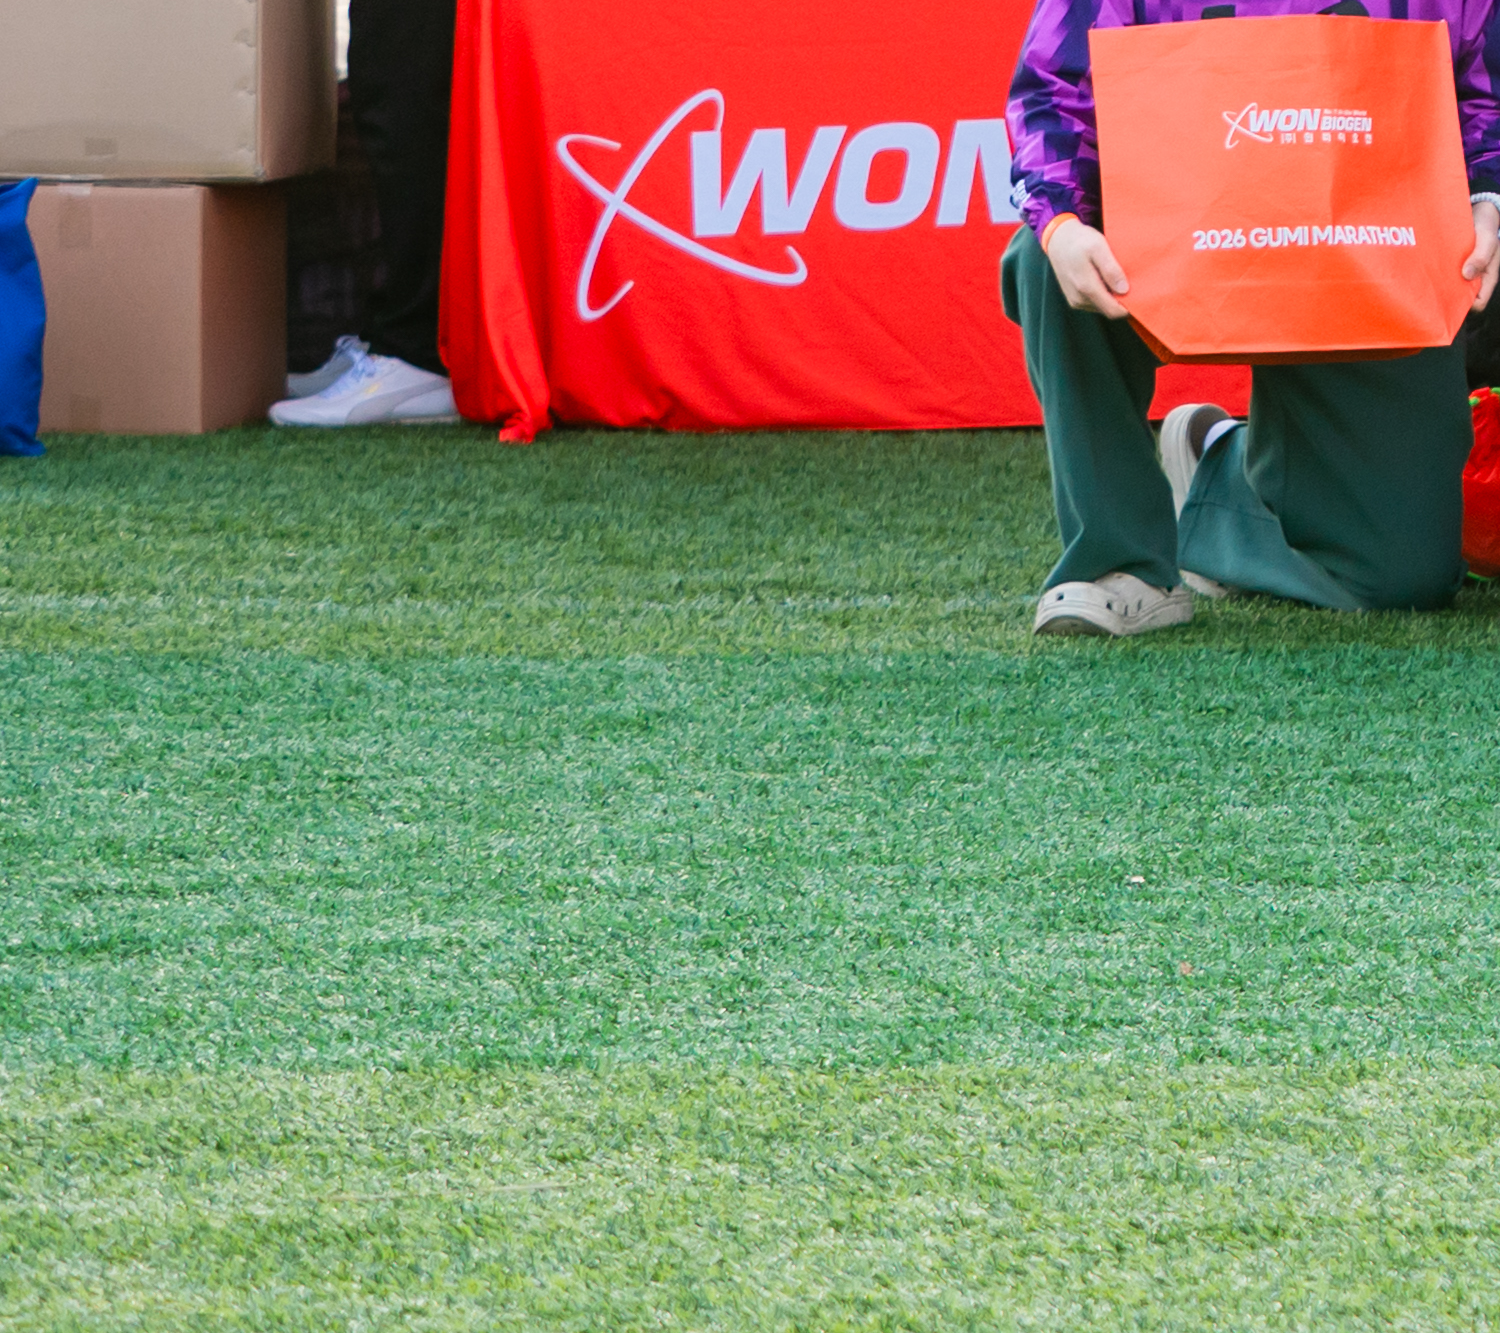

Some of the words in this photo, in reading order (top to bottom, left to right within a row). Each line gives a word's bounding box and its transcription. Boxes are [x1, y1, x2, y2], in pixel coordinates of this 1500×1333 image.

[1248, 109, 1321, 131] WON
[1320, 117, 1371, 132] BIOGEN
[1192, 228, 1247, 251] 2026
[1248, 226, 1309, 248] GUMI
[1311, 225, 1416, 246] MARATHON
